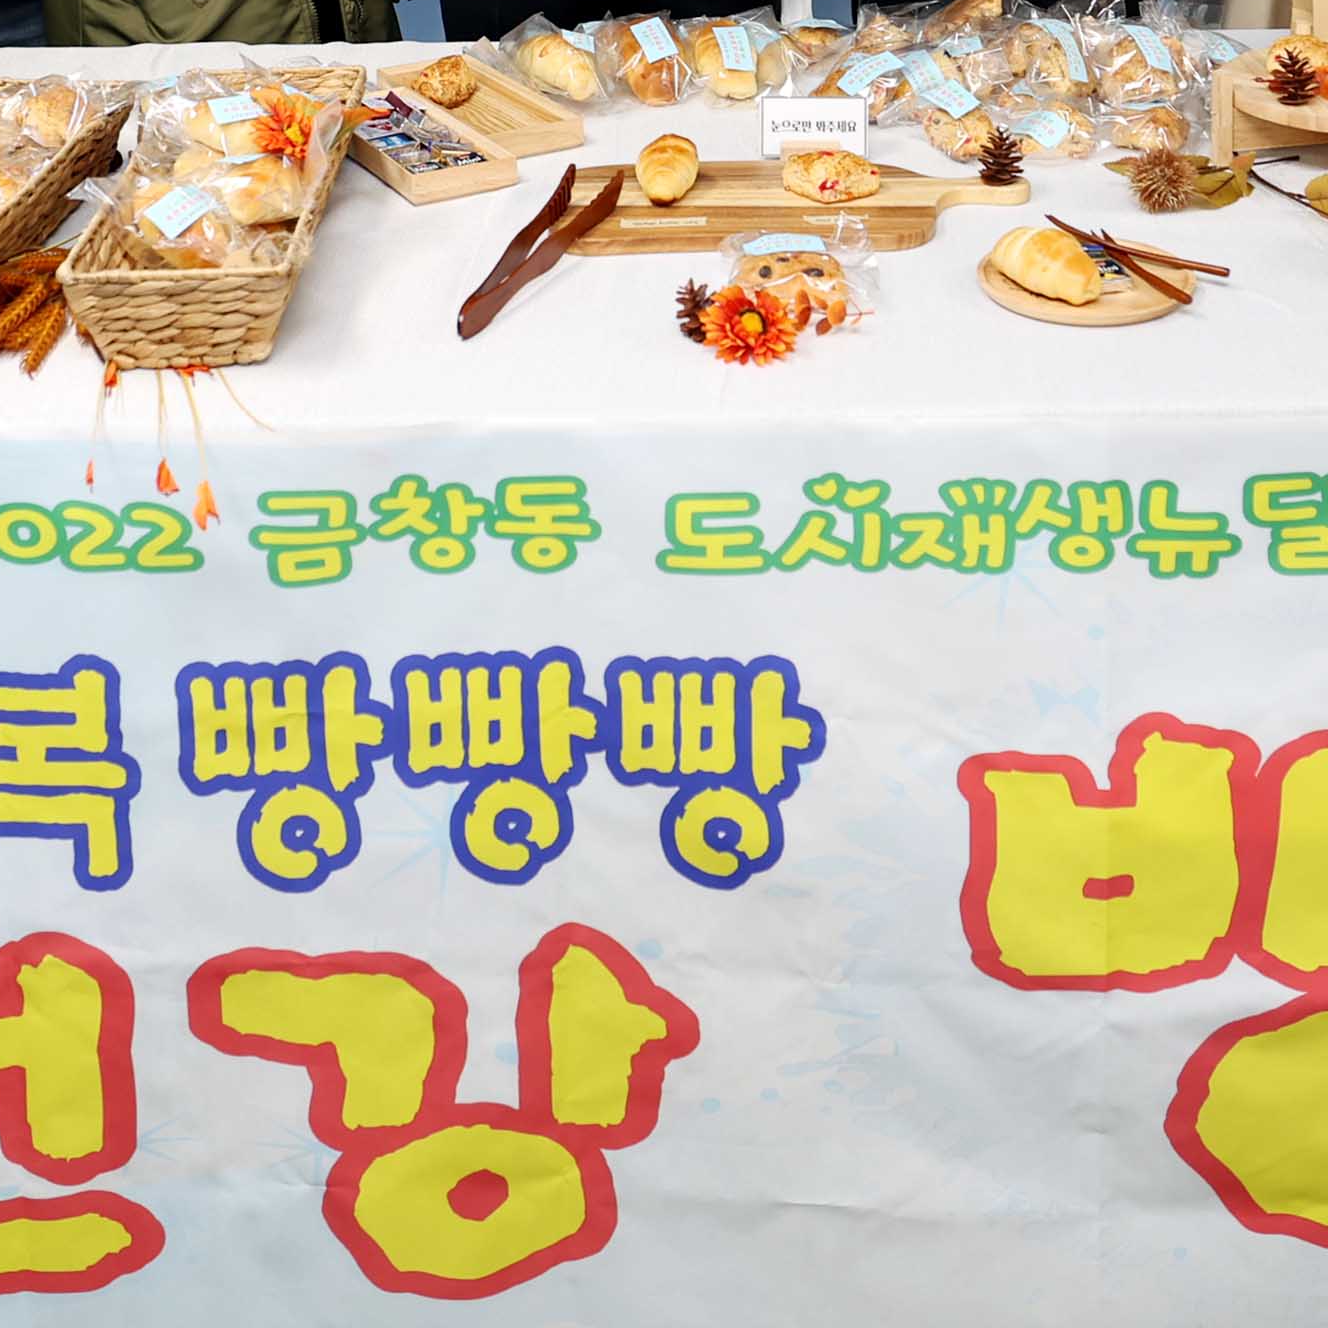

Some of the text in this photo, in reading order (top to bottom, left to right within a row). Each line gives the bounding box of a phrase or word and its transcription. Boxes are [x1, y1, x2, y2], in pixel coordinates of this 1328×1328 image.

[771, 119, 857, 133] 눈으로만 봐주세요
[250, 475, 601, 588] 금창동
[175, 646, 826, 893] 빵빵빵
